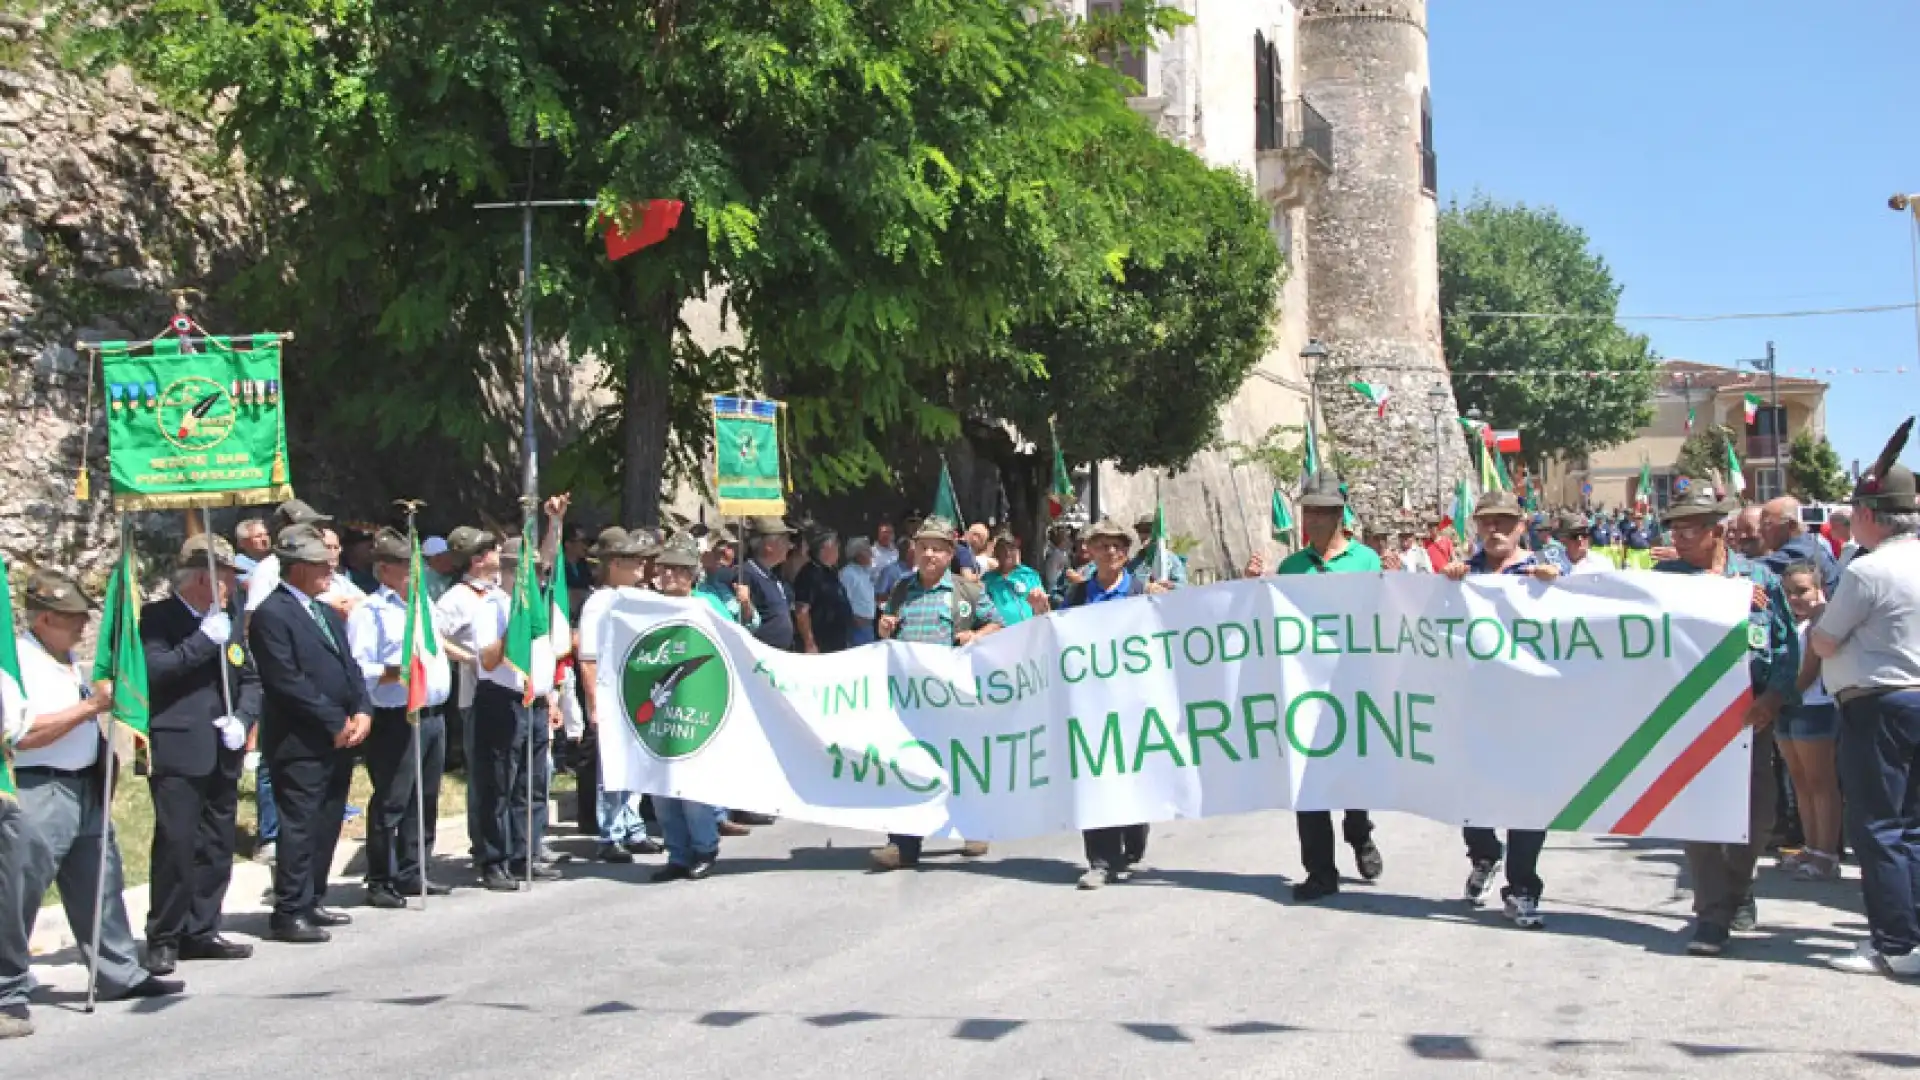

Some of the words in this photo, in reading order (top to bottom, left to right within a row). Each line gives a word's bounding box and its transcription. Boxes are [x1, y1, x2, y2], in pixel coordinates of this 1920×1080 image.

[1060, 617, 1265, 683] CUSTODI
[1618, 611, 1671, 659] DI
[648, 721, 698, 740] ALPINI
